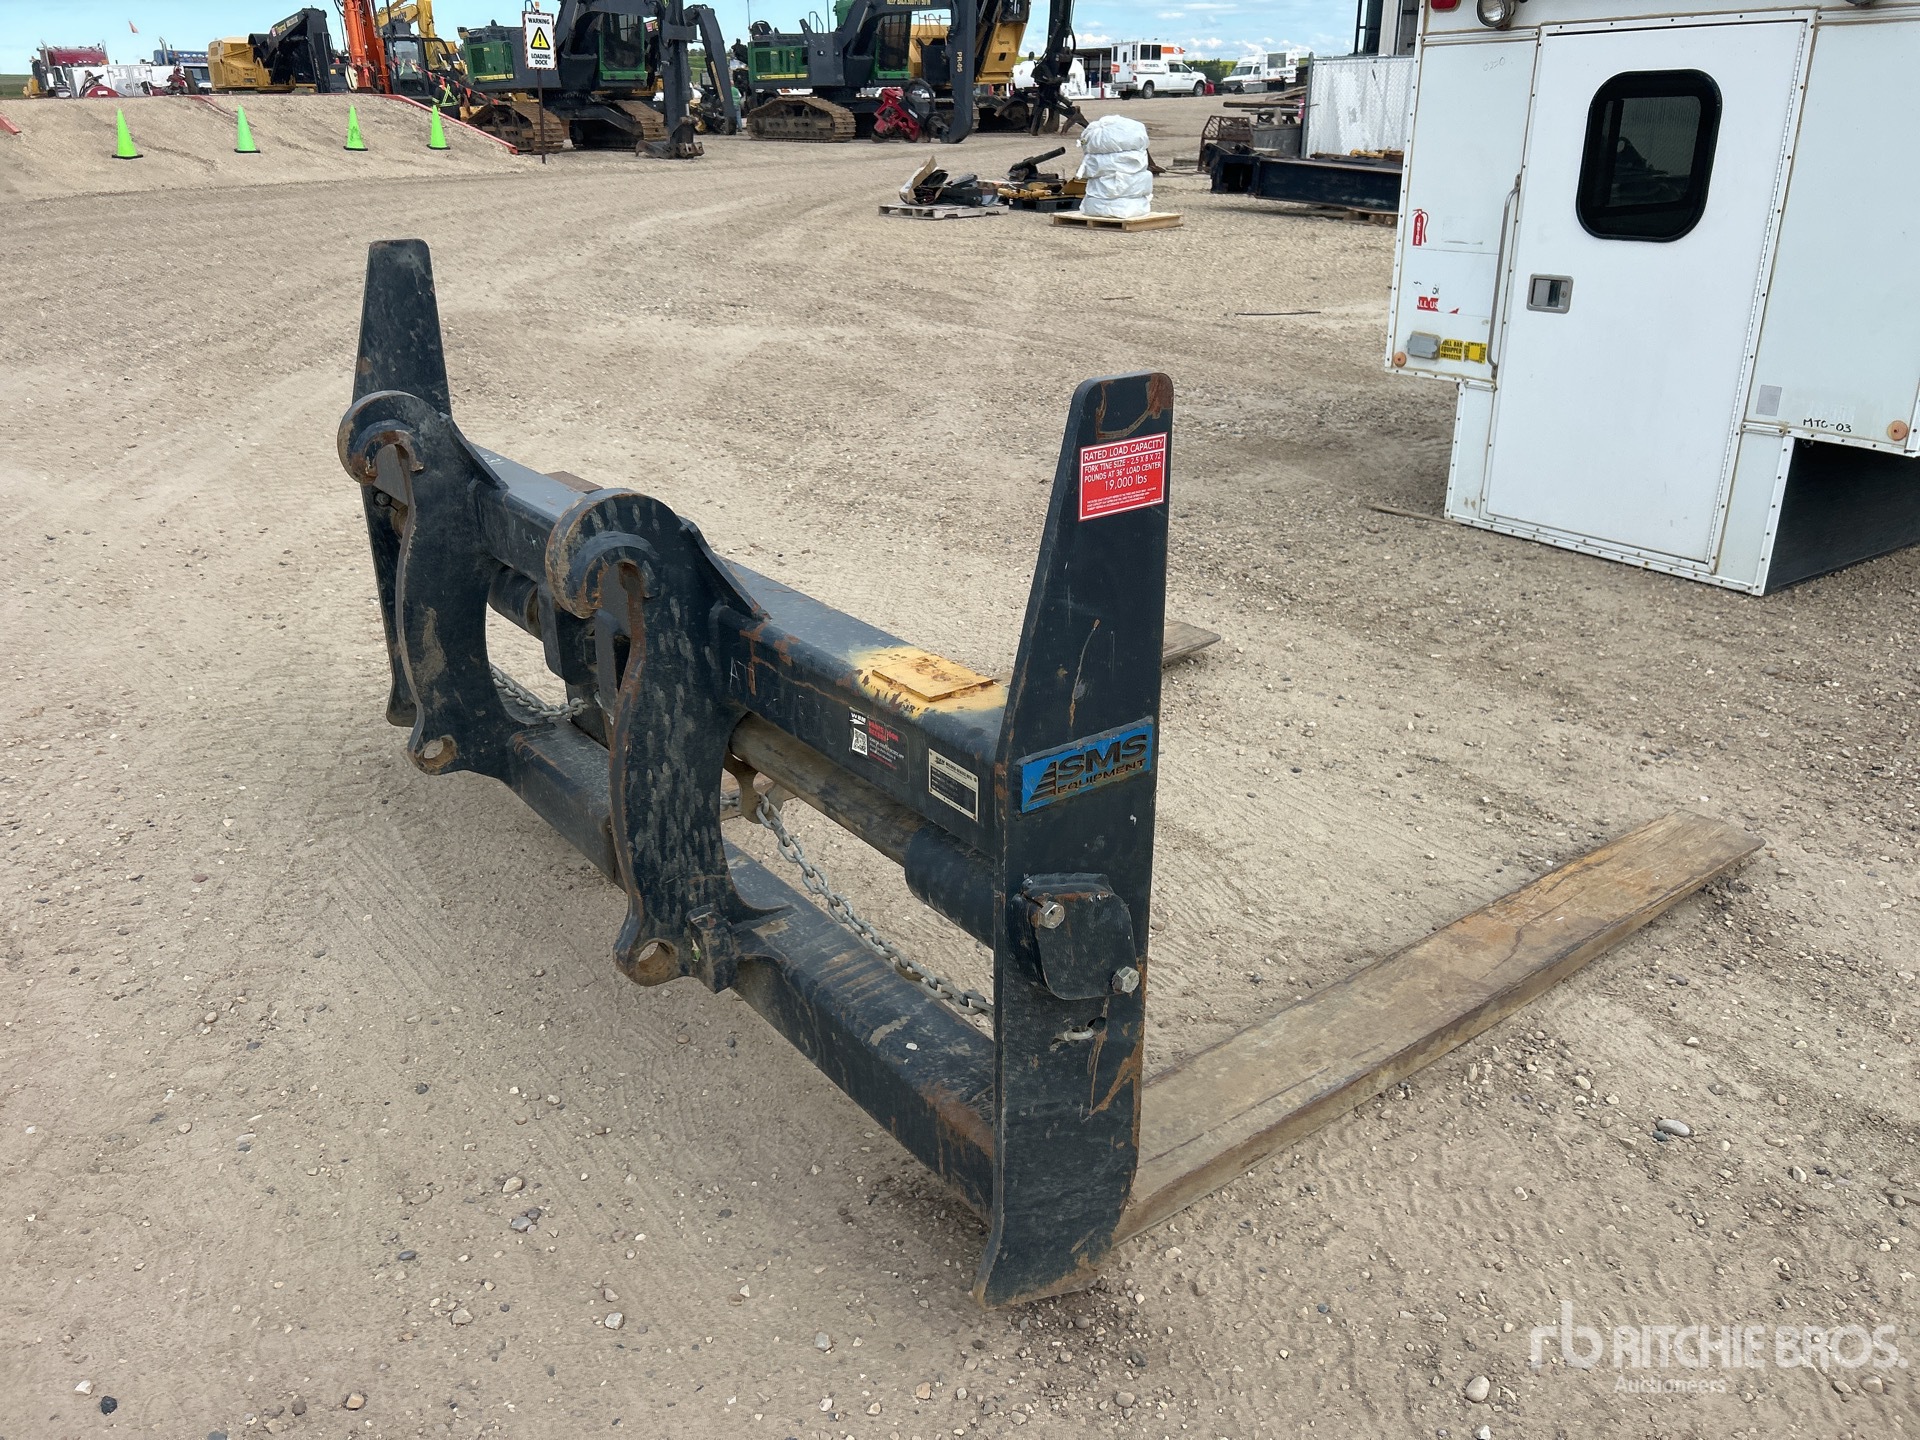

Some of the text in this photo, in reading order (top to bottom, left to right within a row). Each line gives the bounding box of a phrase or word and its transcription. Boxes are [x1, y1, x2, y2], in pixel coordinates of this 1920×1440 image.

[528, 17, 550, 25] WARNING
[1803, 418, 1851, 433] MTC-03
[1084, 439, 1163, 461] RATED LOAD CAPACITY
[1084, 462, 1099, 473] FORK
[1100, 460, 1112, 470] TINE
[1113, 458, 1126, 468] SIZE
[1130, 457, 1139, 465] 2.5
[1140, 455, 1144, 463] X
[1149, 453, 1154, 461] X
[1084, 472, 1106, 483] POUNDS
[1108, 470, 1115, 479] AT
[1126, 466, 1140, 474] LOAD
[1141, 461, 1162, 472] CENTER
[1105, 473, 1148, 491] 19,000 lbs
[850, 712, 867, 724] WBM
[1058, 734, 1147, 781] SMS
[1057, 758, 1147, 794] EQUIPMENT
